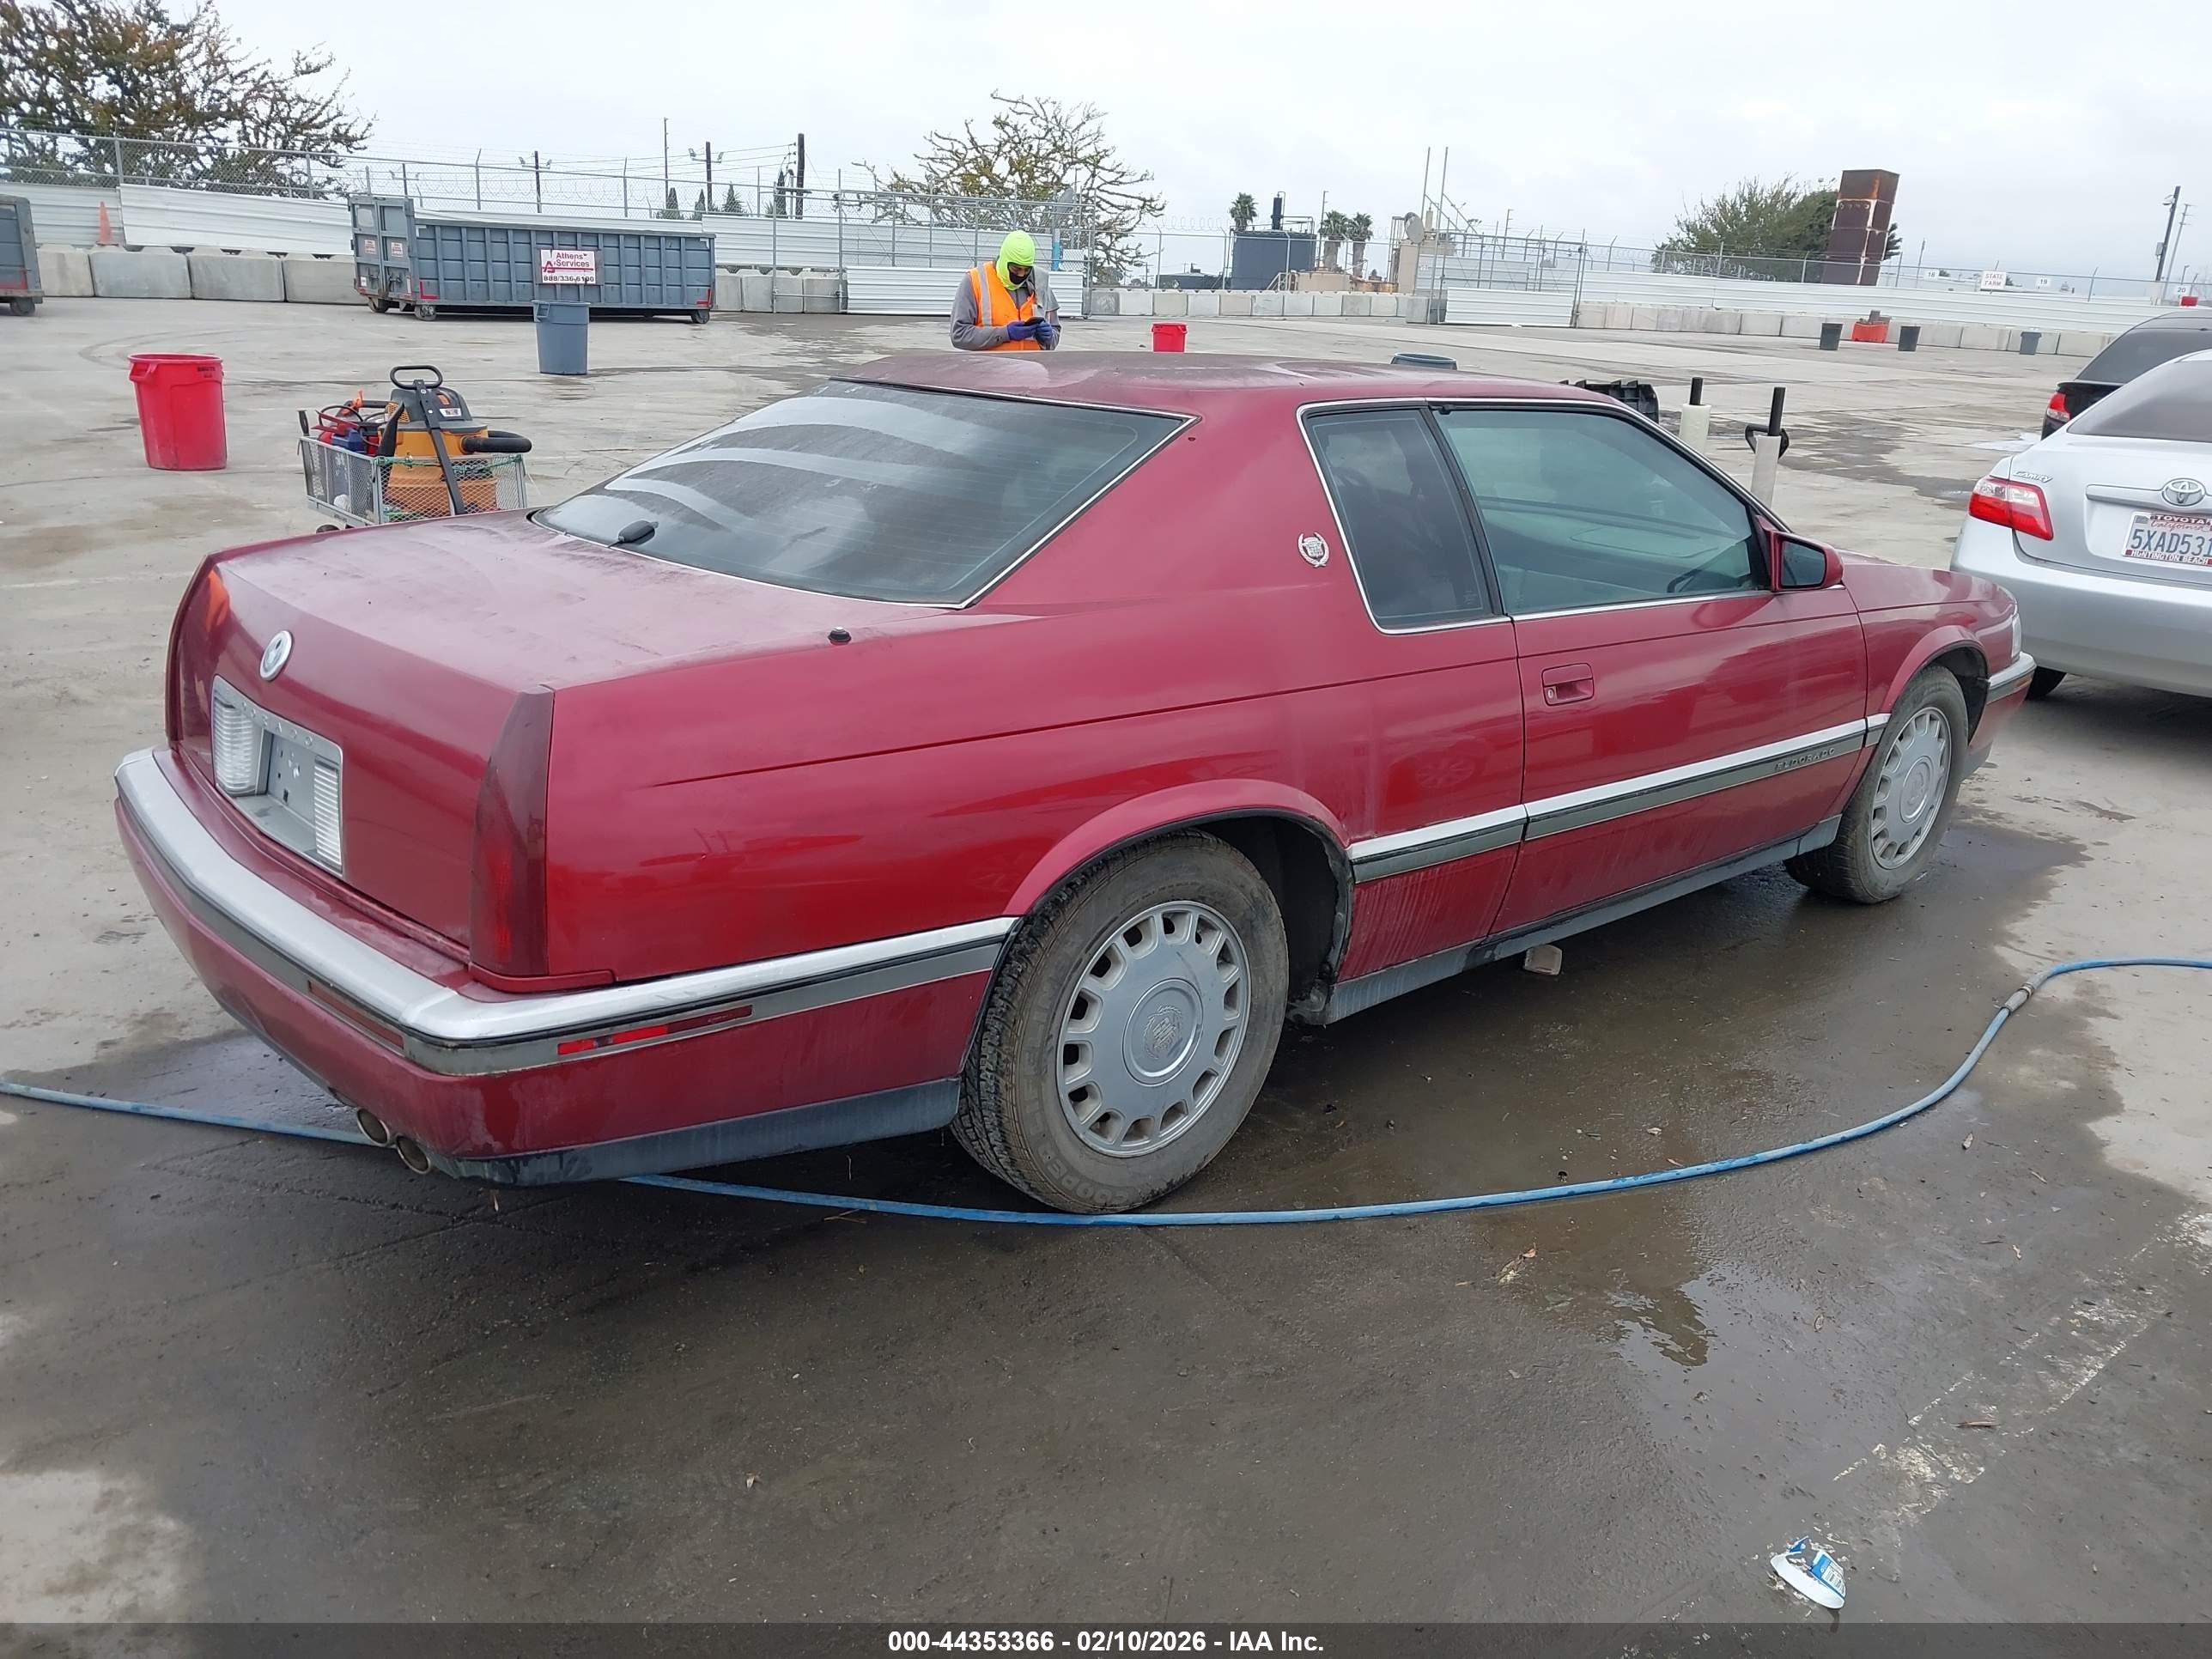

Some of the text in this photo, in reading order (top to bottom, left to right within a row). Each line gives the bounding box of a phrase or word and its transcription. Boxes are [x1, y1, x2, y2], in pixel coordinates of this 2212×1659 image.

[556, 252, 584, 260] Athens
[2013, 471, 2053, 483] CAMRY
[2155, 514, 2205, 525] TOYOTA
[2130, 528, 2212, 557] 5XAD531
[2131, 549, 2209, 565] HUNTINGTON BEACH
[1775, 747, 1836, 771] ELDORADO
